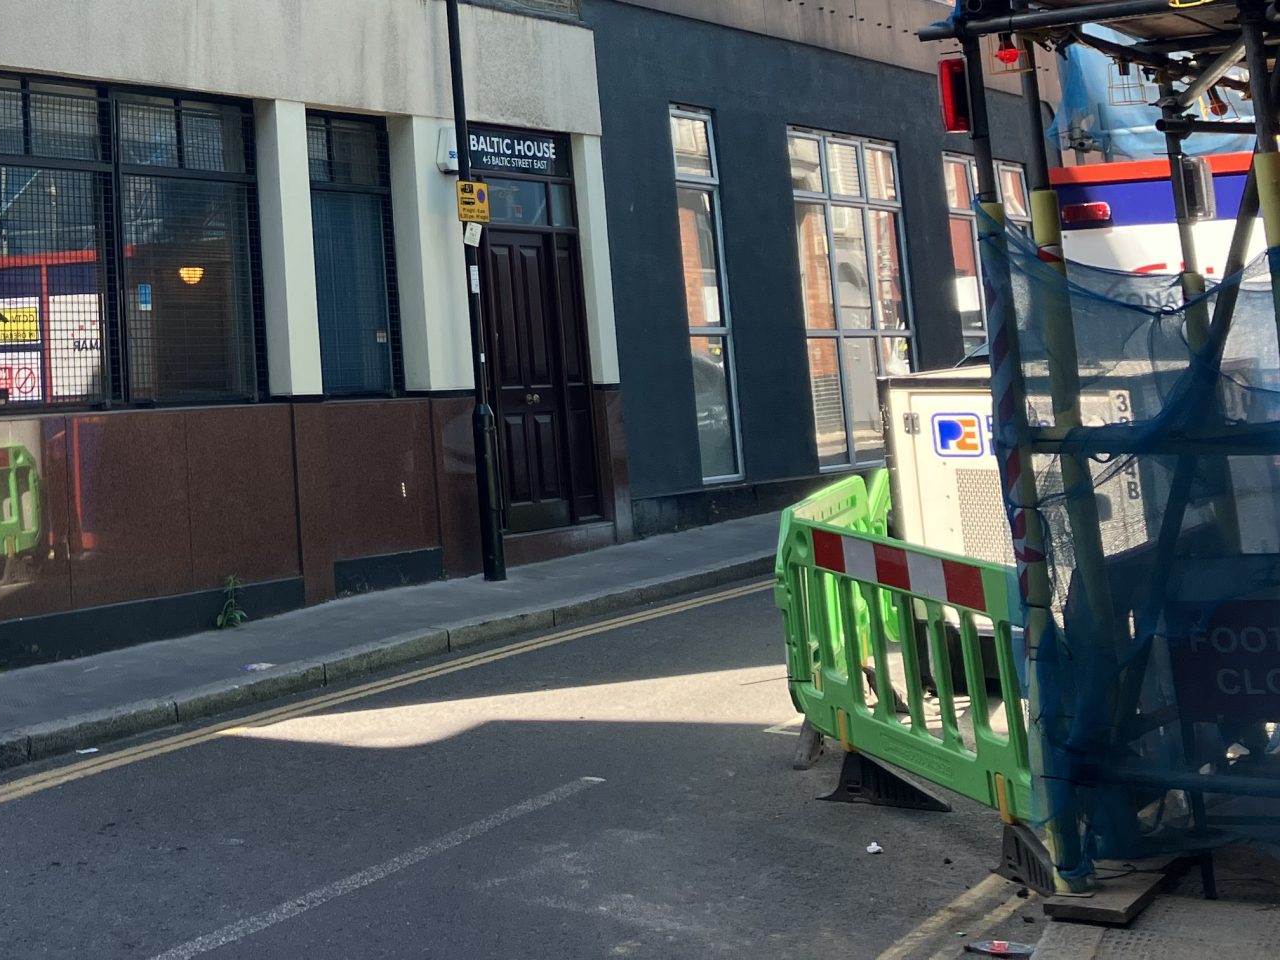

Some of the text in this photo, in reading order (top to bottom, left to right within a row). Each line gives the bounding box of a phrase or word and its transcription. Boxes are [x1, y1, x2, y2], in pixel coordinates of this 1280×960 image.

[469, 134, 512, 155] BALTIC
[514, 139, 556, 159] HOUSE
[491, 156, 511, 167] BALTIC
[511, 157, 533, 169] STREET
[533, 159, 547, 170] EAST
